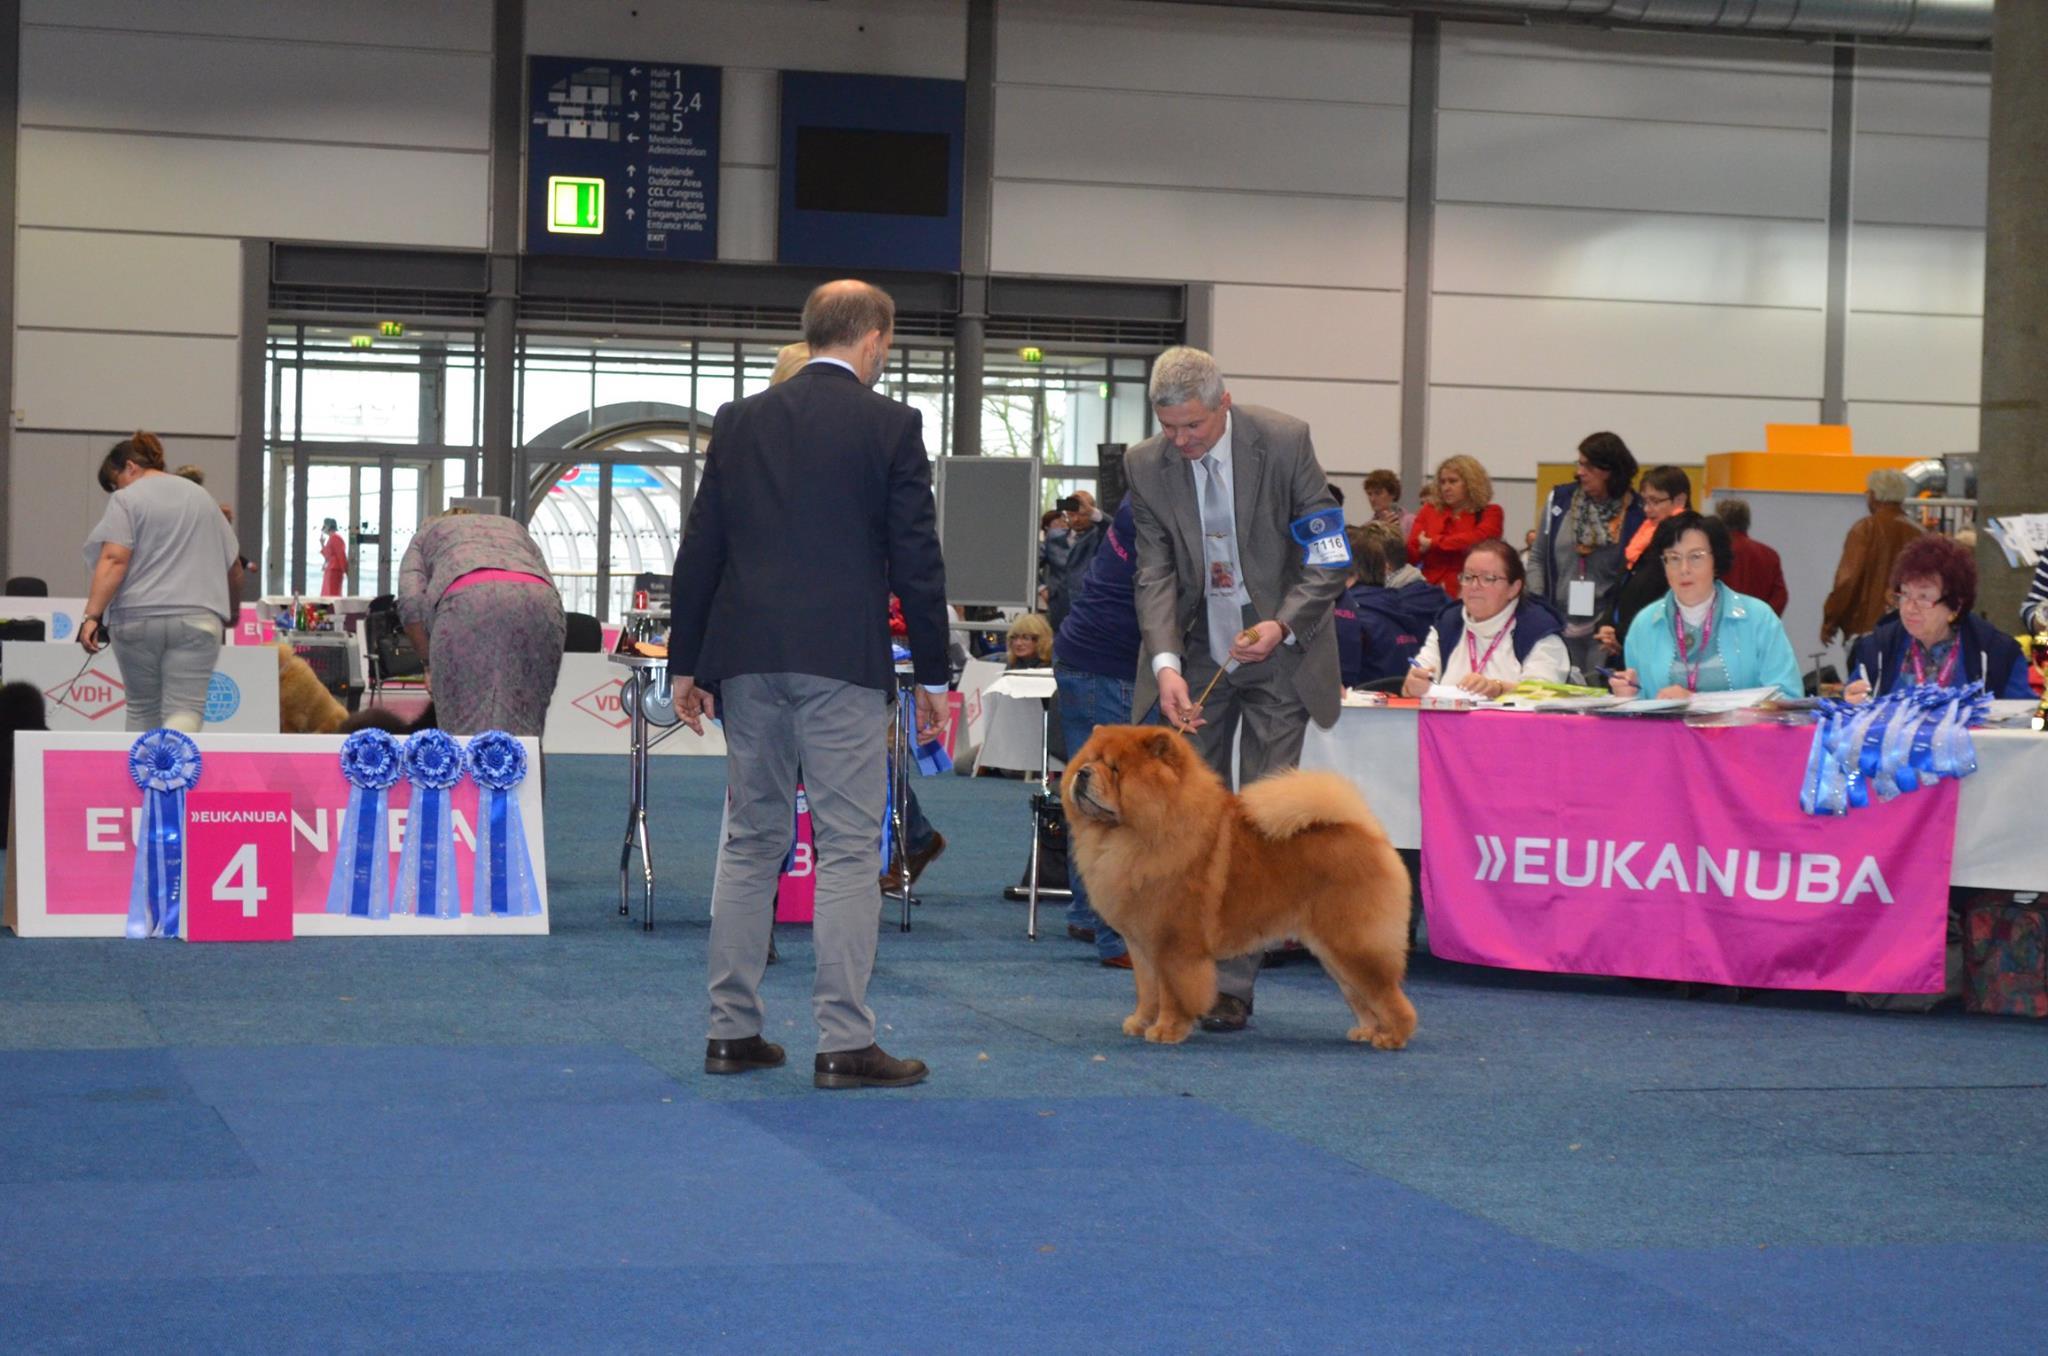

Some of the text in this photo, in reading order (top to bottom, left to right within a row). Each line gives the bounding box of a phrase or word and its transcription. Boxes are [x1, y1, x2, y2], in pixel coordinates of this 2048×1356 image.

[673, 69, 681, 89] 1
[673, 91, 702, 113] 2,4
[672, 113, 683, 132] 5
[648, 145, 707, 157] Administration
[648, 176, 702, 188] Outdoor Area
[648, 187, 703, 200] CCL Congress
[648, 198, 705, 212] Center Leipzig
[647, 209, 707, 221] Eingangshallen
[647, 220, 703, 232] Entrance Halls
[647, 233, 666, 241] EXIT
[1314, 537, 1343, 553] 7116
[71, 686, 112, 703] VDH
[595, 695, 620, 712] VD
[200, 811, 288, 823] EUKANUBA
[1514, 837, 1894, 903] EUKANUBA
[212, 843, 268, 918] 4
